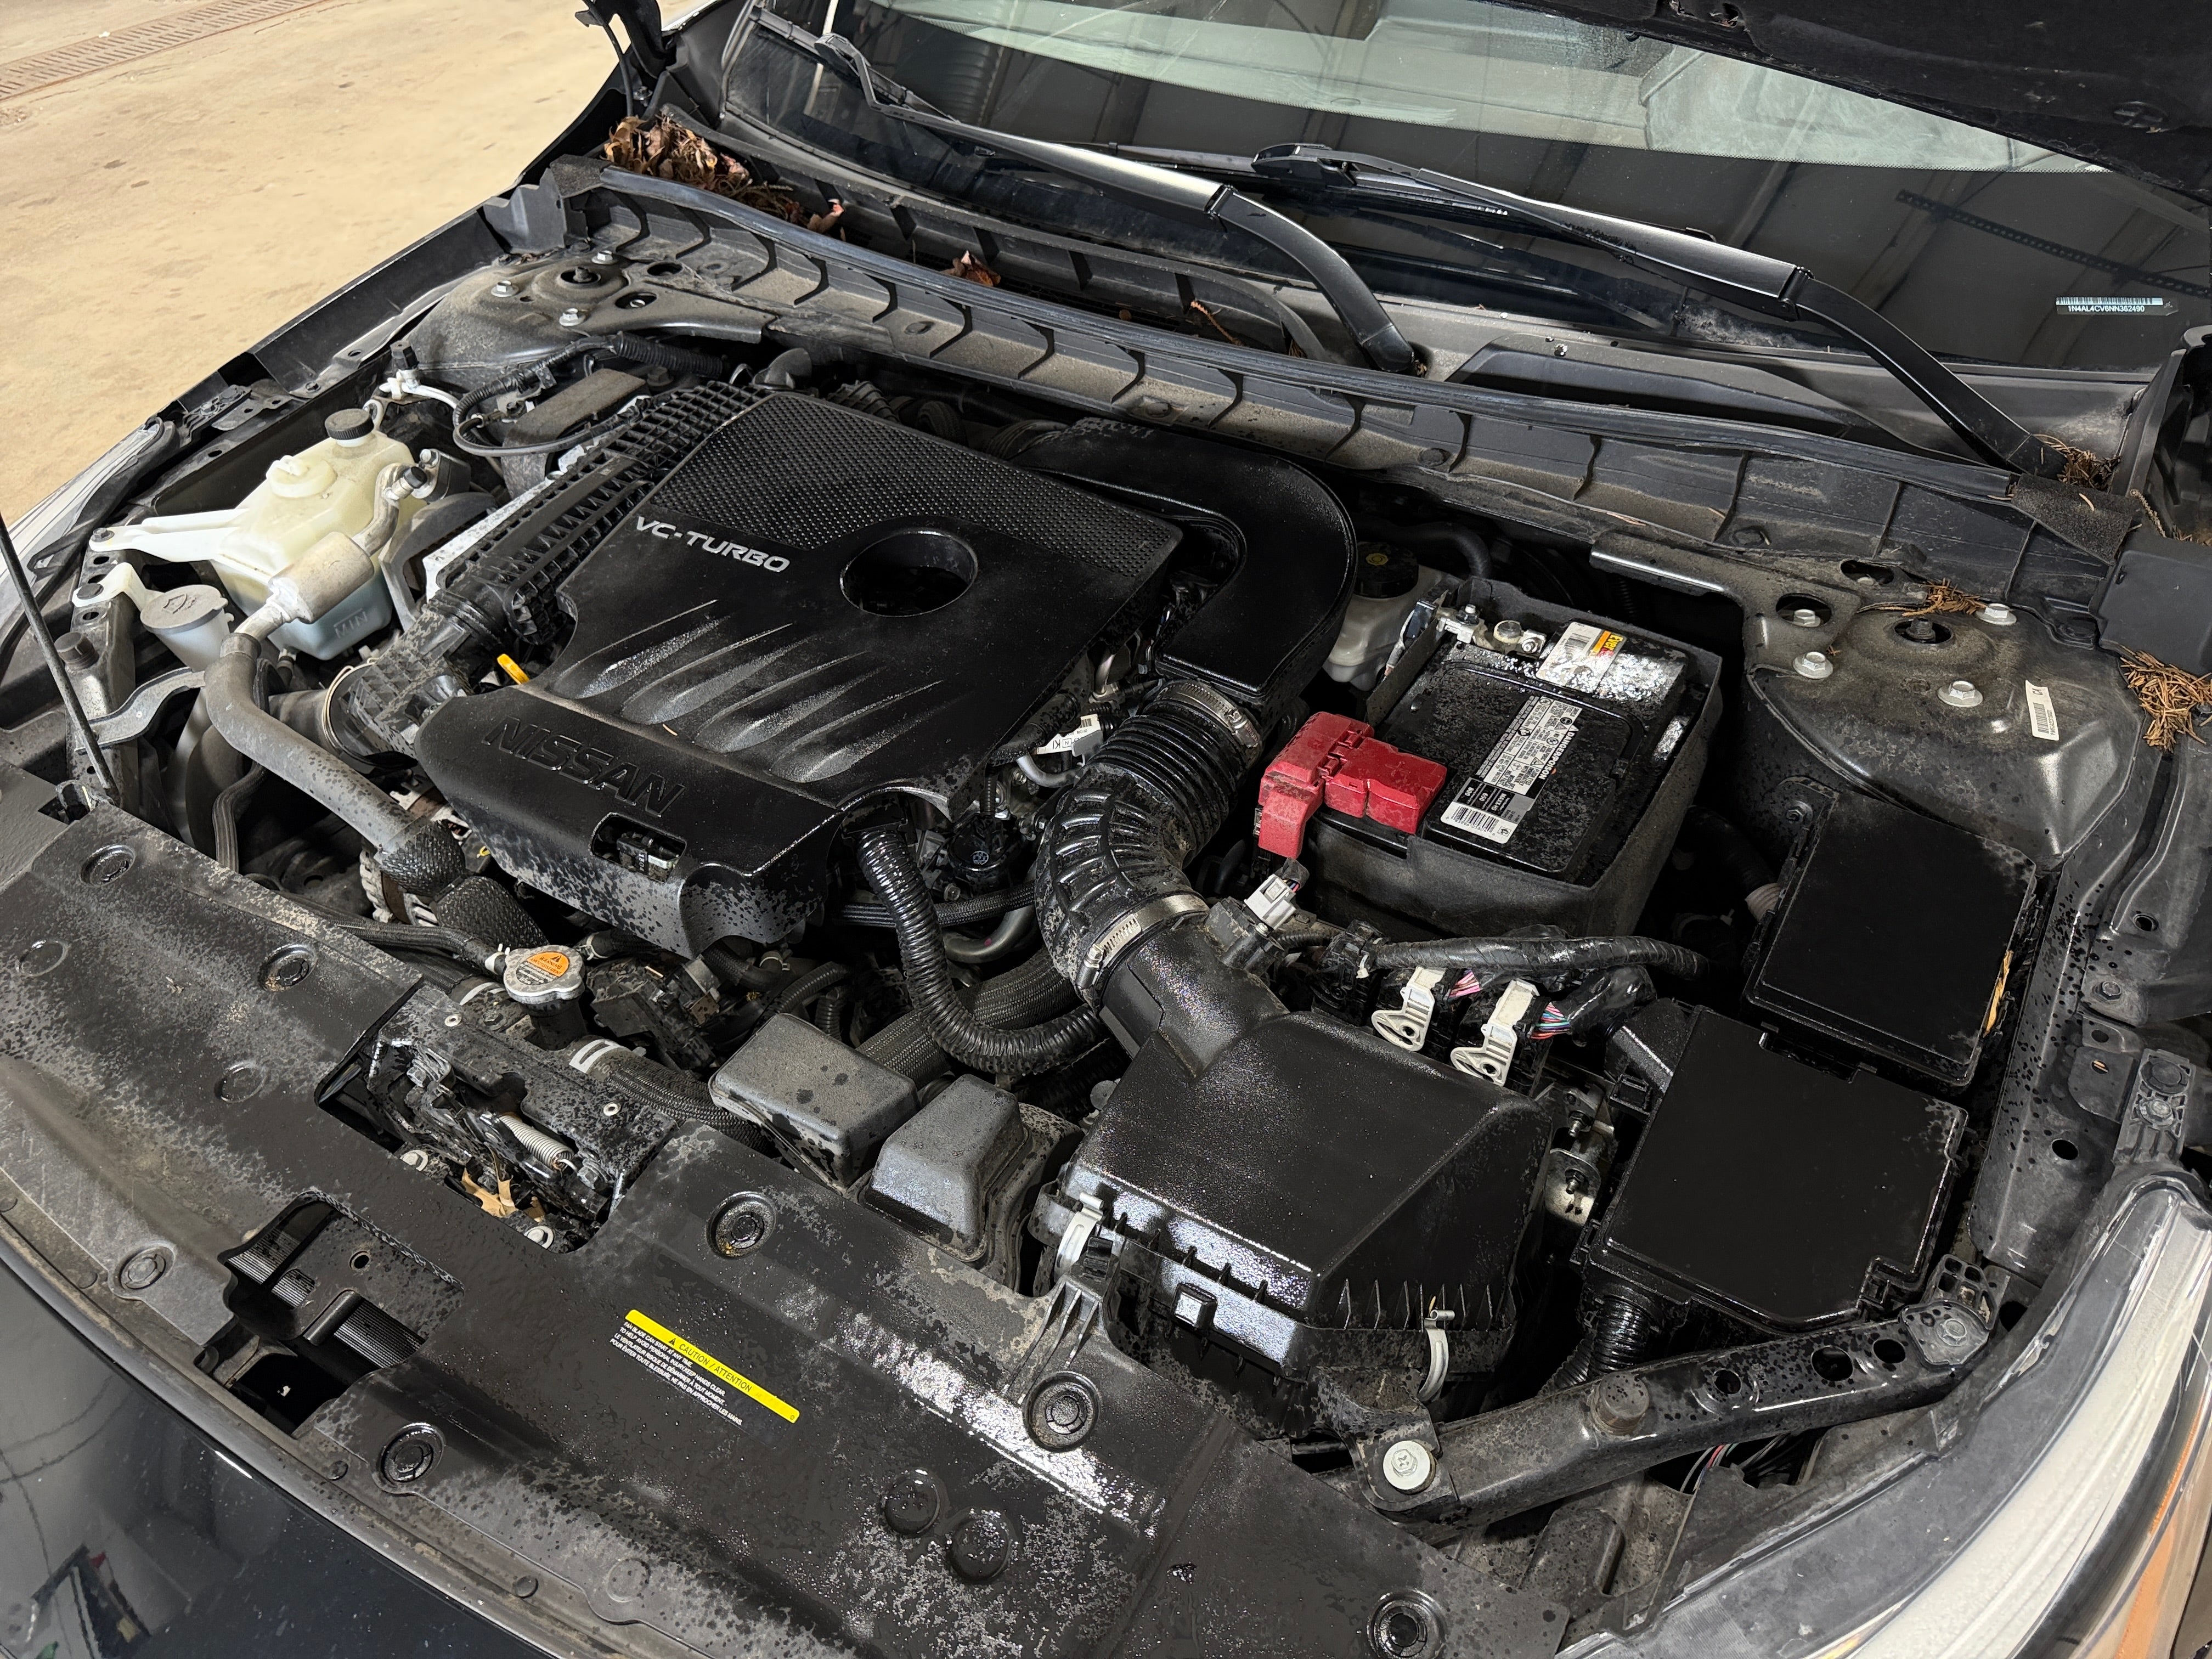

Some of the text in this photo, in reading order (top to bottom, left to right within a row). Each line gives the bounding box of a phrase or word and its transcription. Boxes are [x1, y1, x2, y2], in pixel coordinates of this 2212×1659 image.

[636, 516, 791, 573] VC-TURBO
[335, 611, 368, 639] MIN
[482, 715, 686, 817] NISSAN
[1538, 731, 1575, 780] DANGER/POISON
[1465, 787, 1474, 797] 800
[1479, 792, 1488, 802] 650
[540, 956, 562, 969] WARNING
[619, 1336, 647, 1356] VENTILATEUR
[645, 1352, 662, 1365] RISQUE
[660, 1361, 668, 1369] DE
[666, 1364, 692, 1384] DÉMARRER
[692, 1382, 706, 1393] TOUT
[623, 1321, 633, 1330] FAN
[631, 1327, 646, 1338] BLADE
[645, 1335, 656, 1344] CAN
[654, 1340, 668, 1352] START
[672, 1351, 683, 1361] ANY
[625, 1330, 637, 1341] HELP
[635, 1337, 650, 1348] AVOID
[648, 1345, 671, 1362] PERSONAL
[694, 1374, 712, 1387] HANDS
[609, 1338, 623, 1349] POUR
[635, 1354, 650, 1366] TOUTE
[670, 1376, 679, 1384] NE
[676, 1380, 687, 1390] PAS
[685, 1386, 694, 1395] EN
[692, 1390, 720, 1411] APPROCHER
[718, 1407, 729, 1417] LES
[678, 1343, 709, 1365] CAUTION
[713, 1365, 752, 1392] ATTENTION
